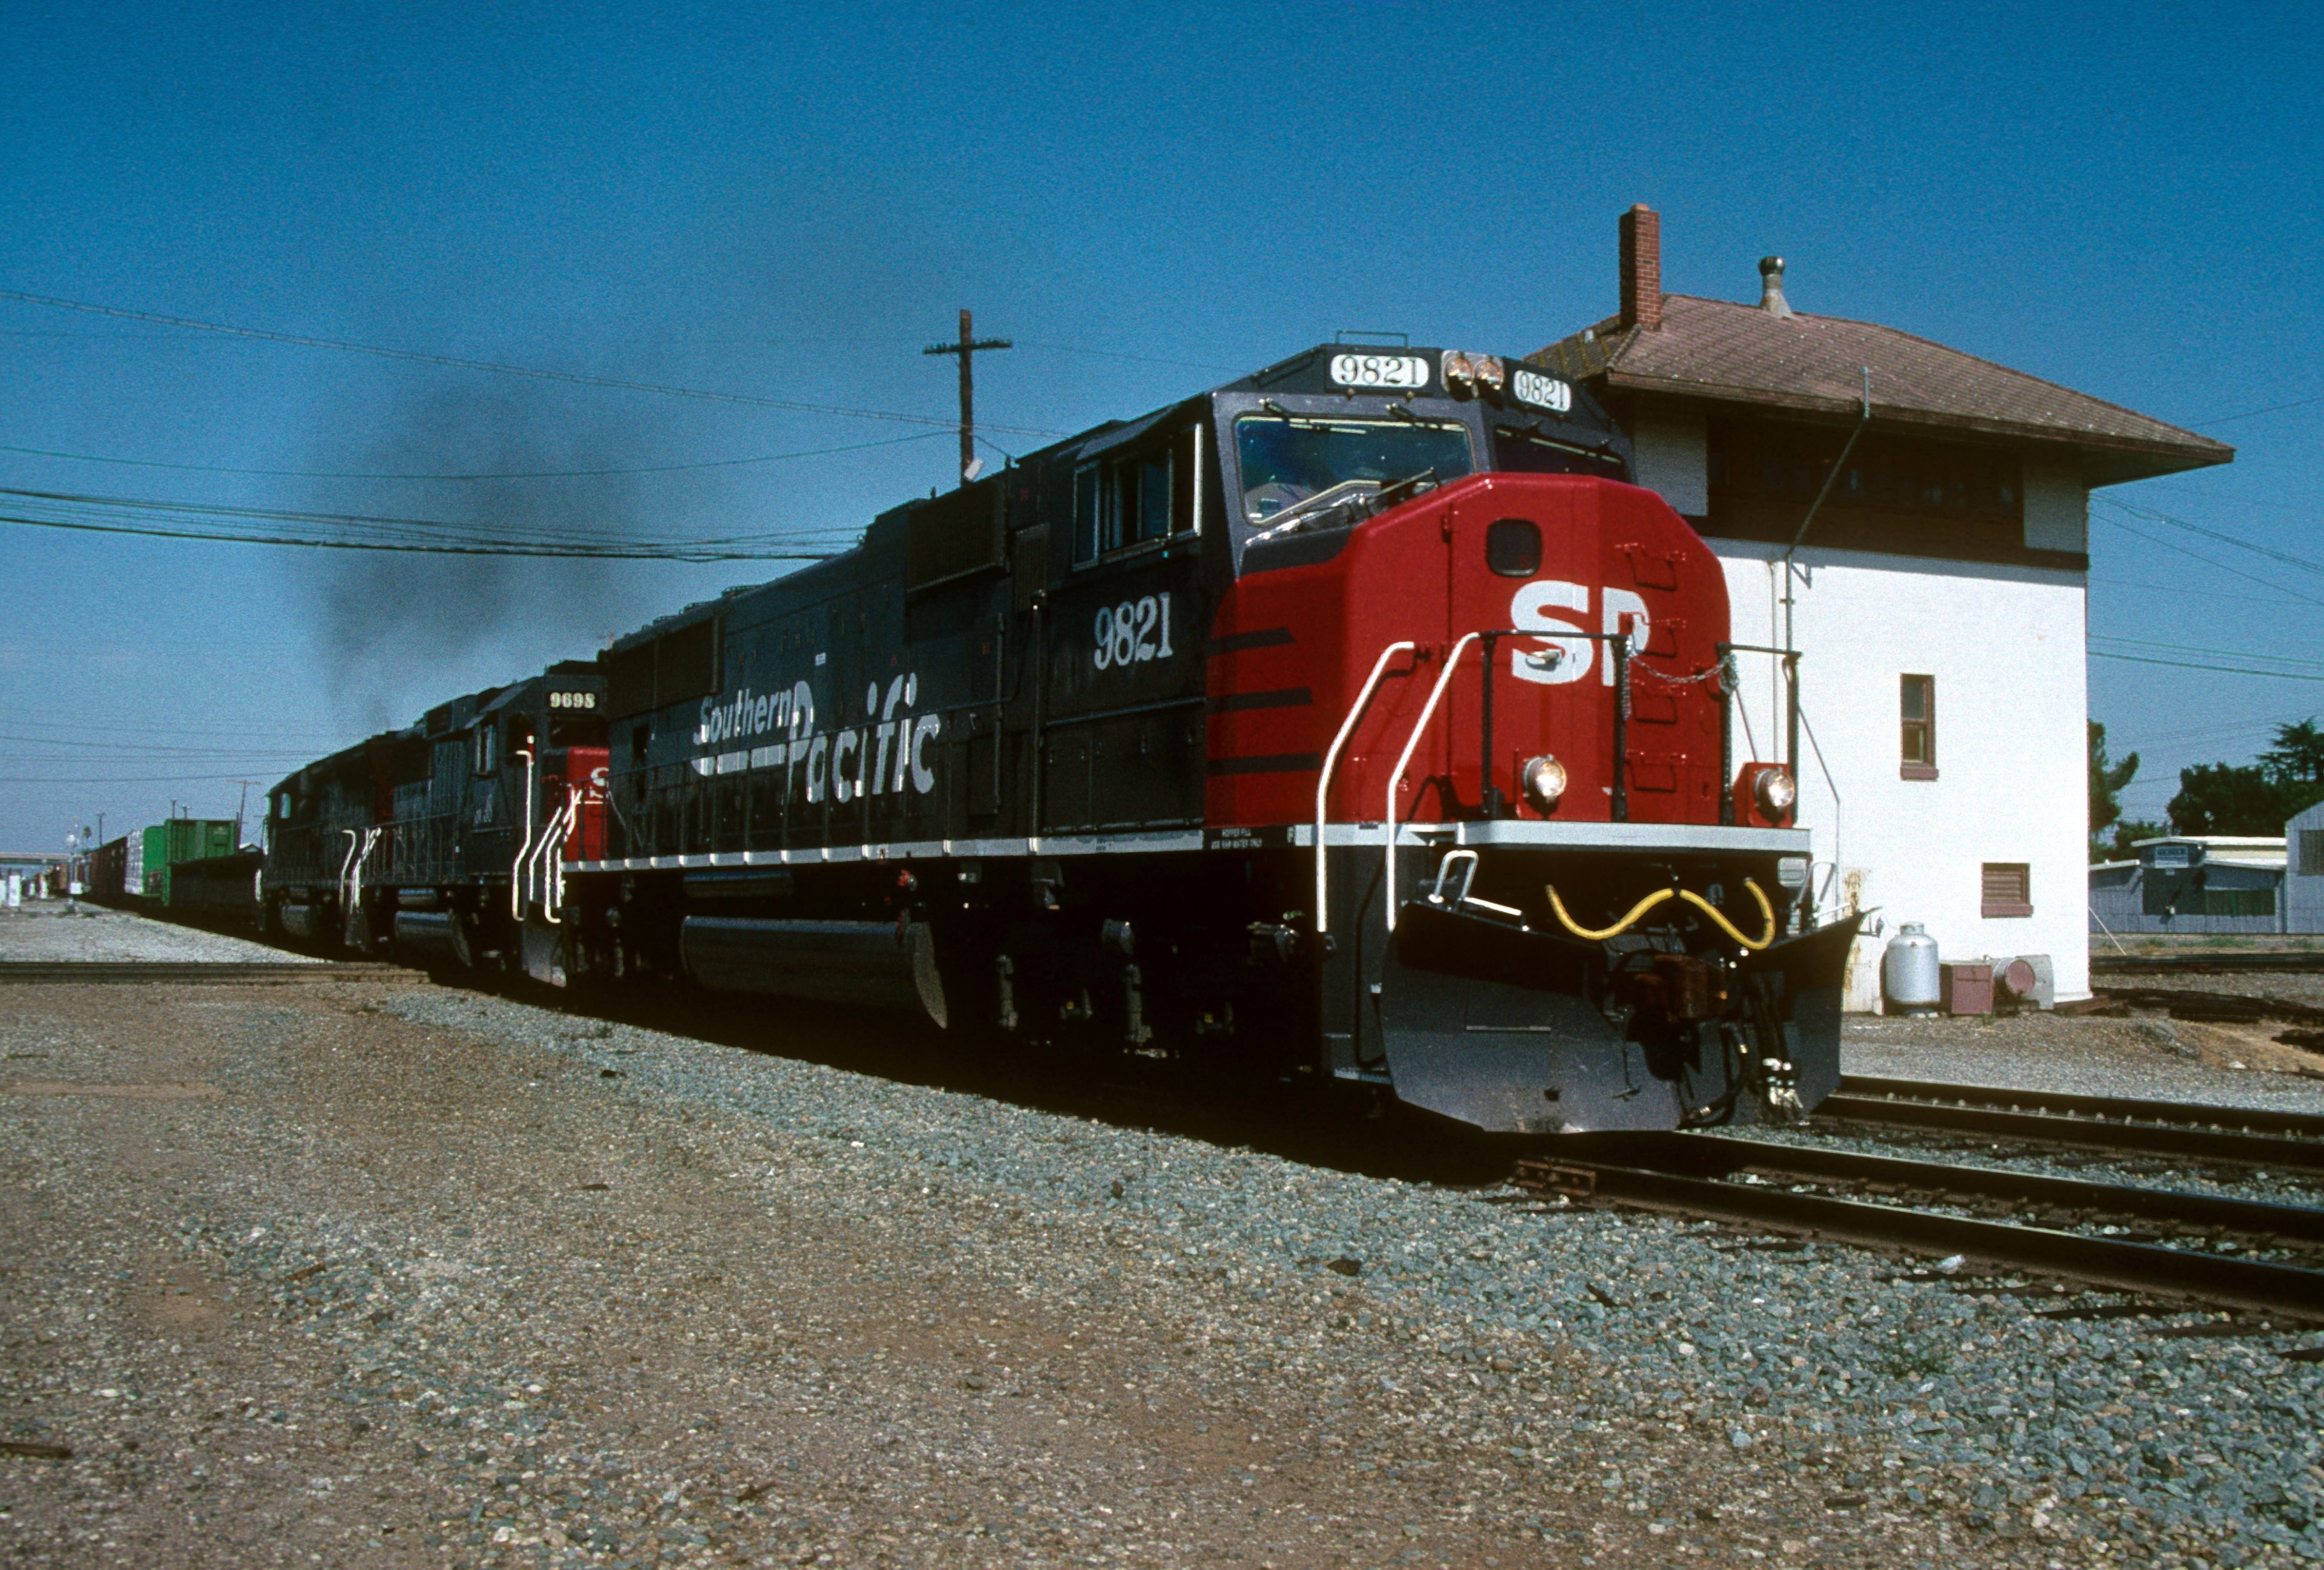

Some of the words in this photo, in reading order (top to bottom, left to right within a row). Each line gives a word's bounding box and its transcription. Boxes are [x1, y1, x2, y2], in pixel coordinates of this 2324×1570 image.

[1340, 356, 1417, 386] 9821
[1519, 371, 1564, 409] 9821
[1094, 591, 1173, 670] 9821
[1511, 580, 1650, 686] SP
[550, 692, 596, 709] 9698
[692, 689, 792, 746] Southern
[787, 672, 941, 804] Pacific
